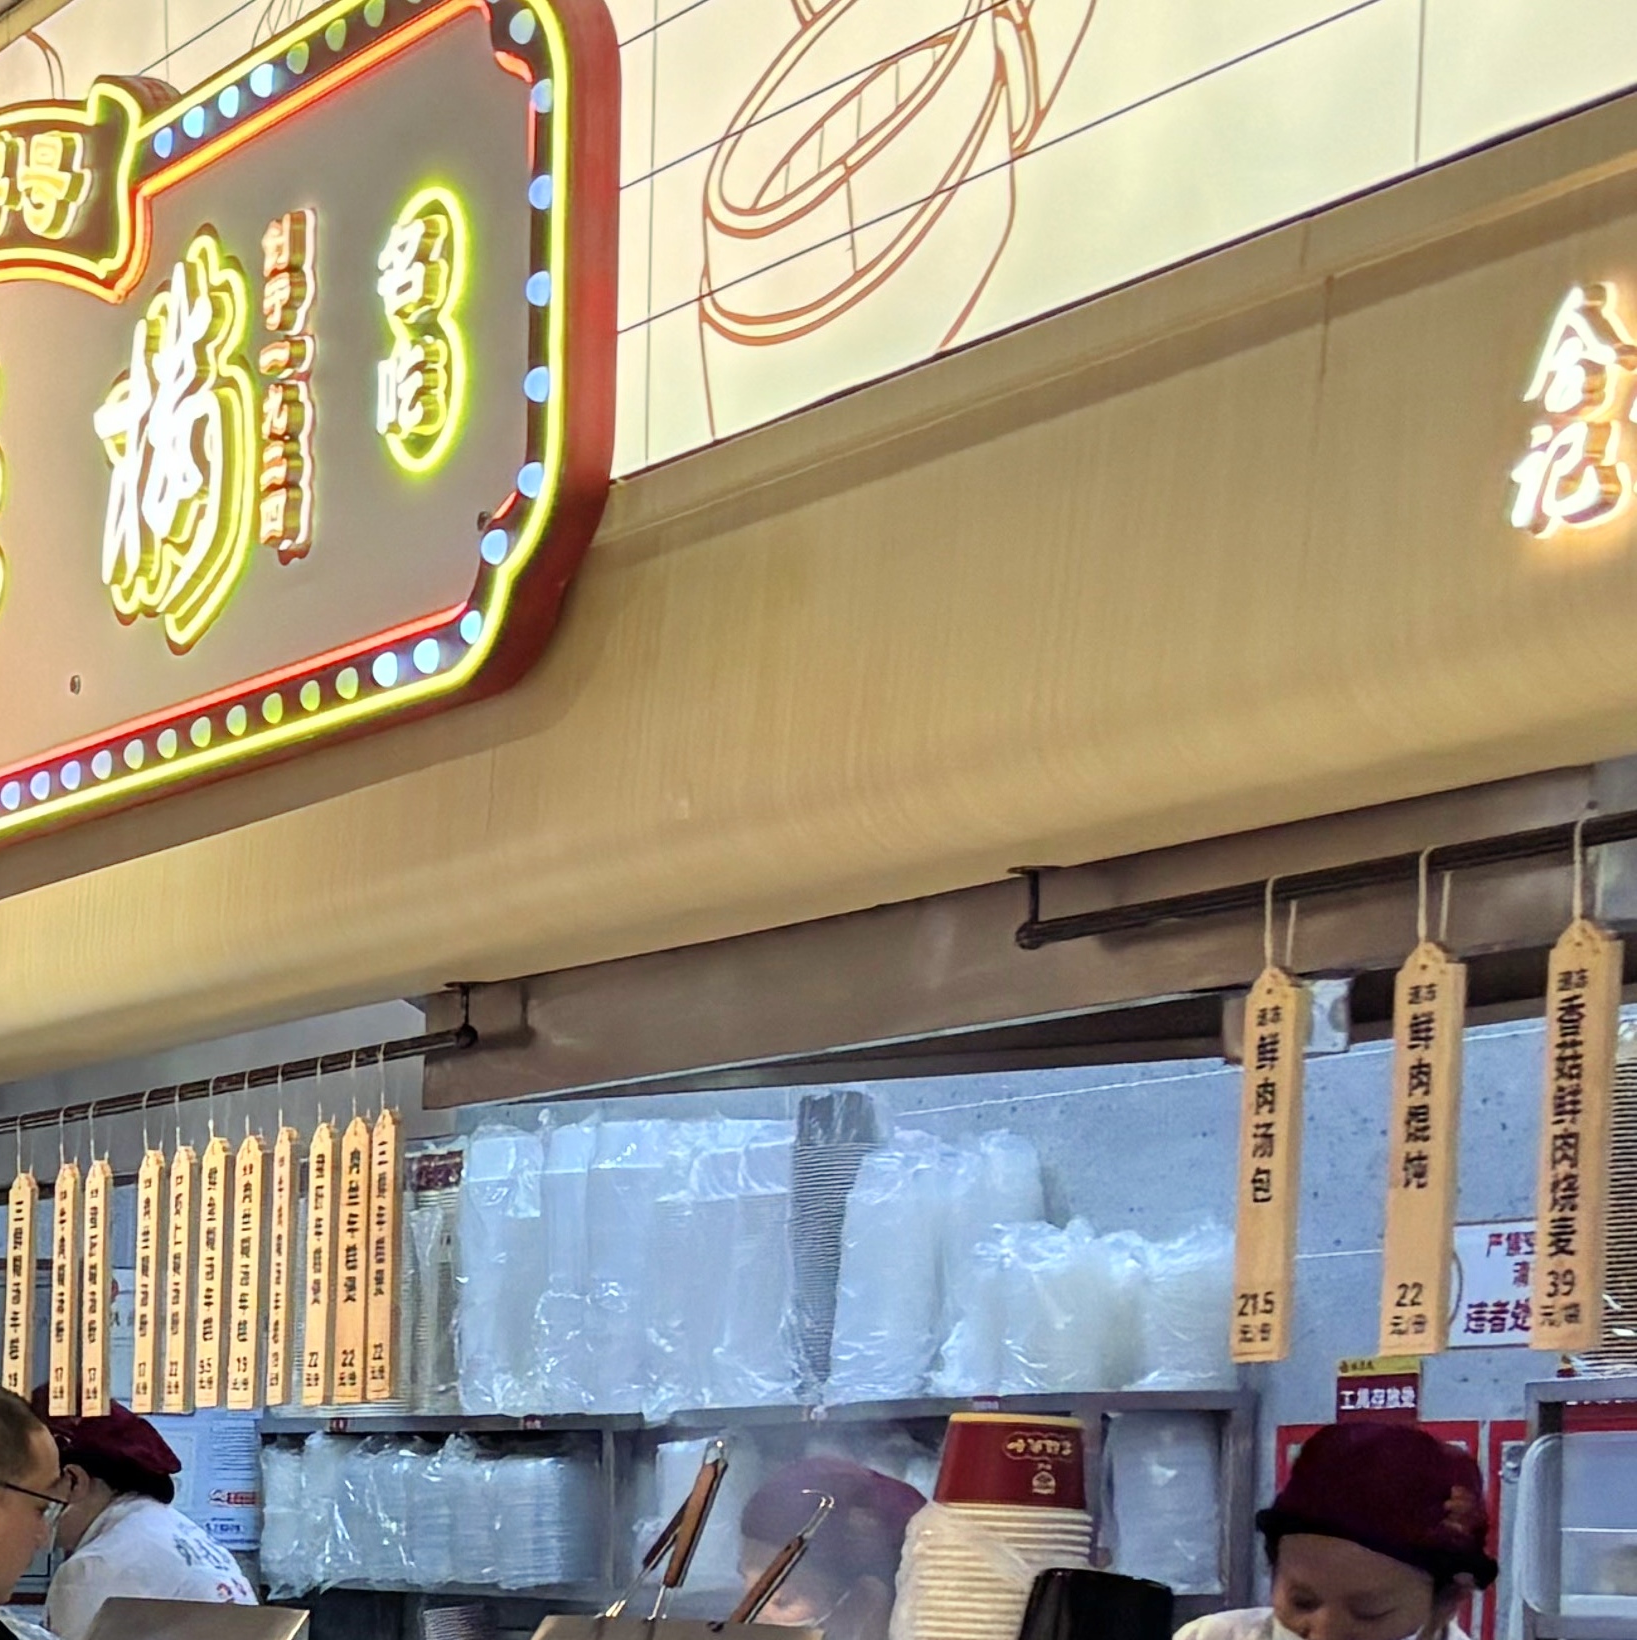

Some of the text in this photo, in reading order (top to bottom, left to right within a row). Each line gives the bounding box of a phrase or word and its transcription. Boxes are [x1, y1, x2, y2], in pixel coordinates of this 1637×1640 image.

[377, 214, 449, 438] 名吃
[1395, 1282, 1424, 1307] 22
[1546, 1269, 1576, 1298] 39
